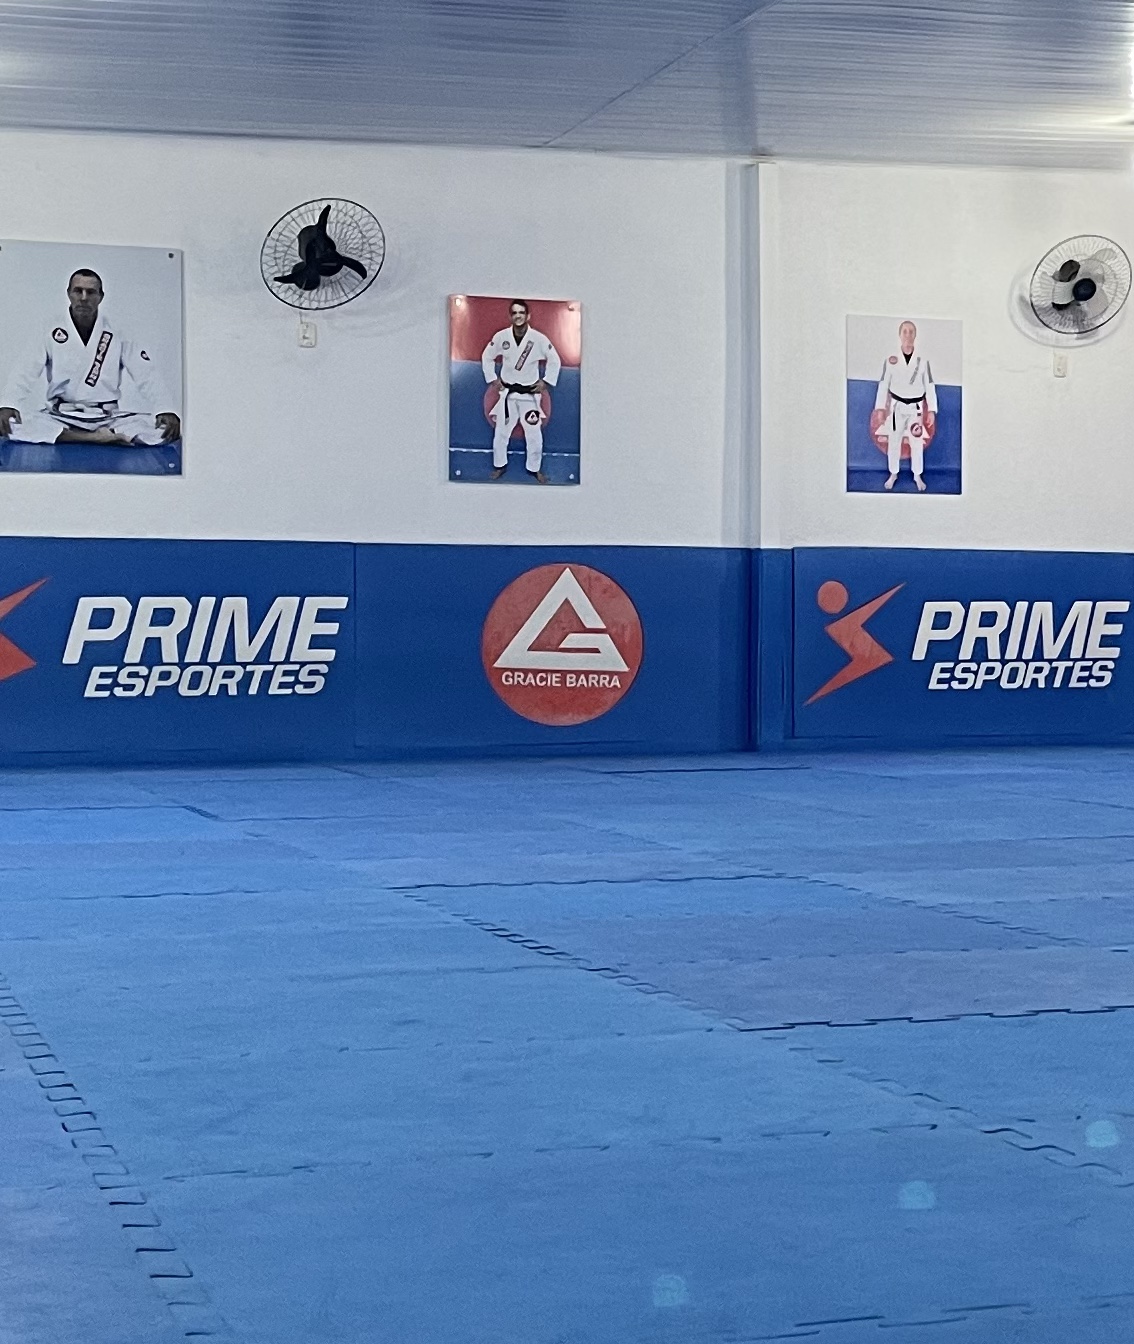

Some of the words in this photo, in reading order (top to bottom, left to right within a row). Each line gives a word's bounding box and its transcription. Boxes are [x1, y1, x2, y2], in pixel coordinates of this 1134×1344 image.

[62, 596, 349, 664] PRIME
[911, 600, 1131, 661] PRIME
[83, 663, 329, 698] ESPORTES
[501, 671, 562, 687] GRACIE
[565, 673, 622, 689] BARRA
[927, 659, 1115, 690] ESPORTES
